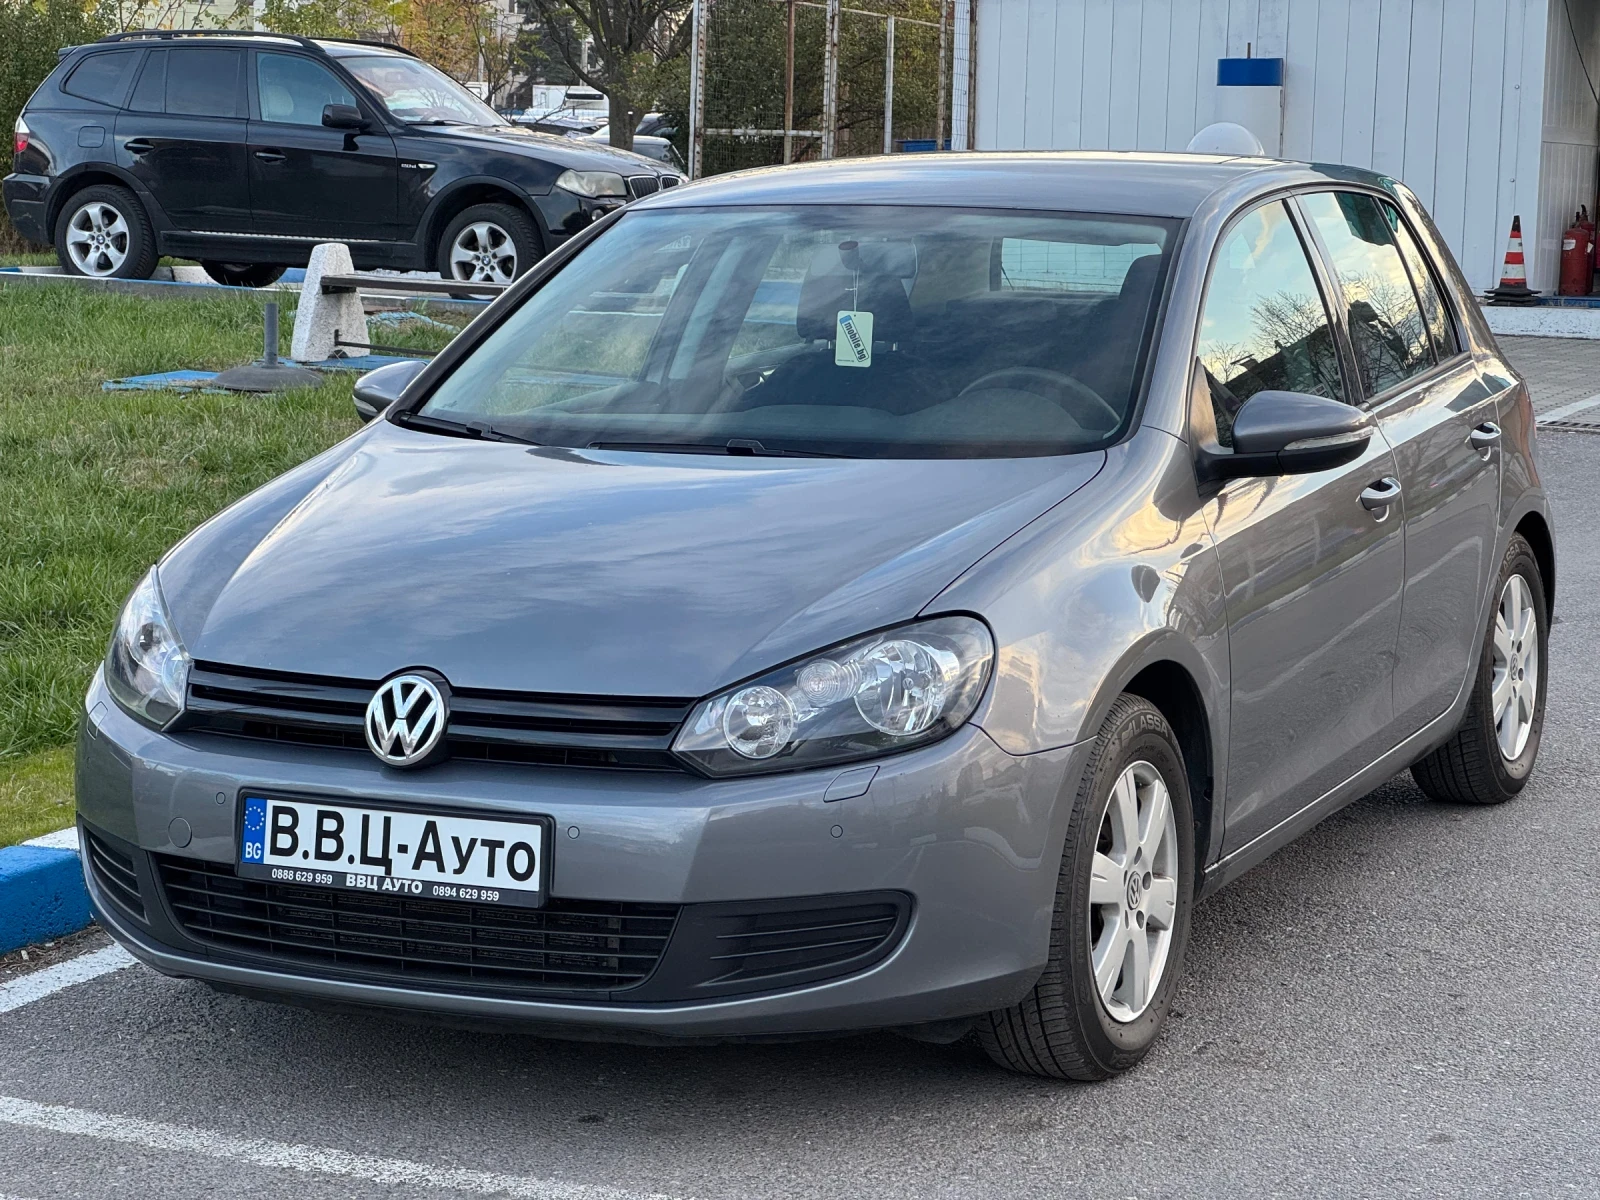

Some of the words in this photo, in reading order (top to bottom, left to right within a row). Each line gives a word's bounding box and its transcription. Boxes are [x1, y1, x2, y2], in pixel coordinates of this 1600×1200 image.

[843, 321, 867, 360] mobile.bg
[366, 675, 445, 765] VW
[1132, 714, 1168, 737] LASSA
[245, 841, 261, 859] BG
[271, 868, 294, 881] 0888
[295, 871, 314, 882] 629
[315, 873, 333, 884] 959
[345, 873, 378, 890] ВВЦ
[381, 877, 423, 894] АУТО
[432, 885, 457, 897] 0894
[459, 888, 478, 899] 629
[480, 890, 500, 901] 959
